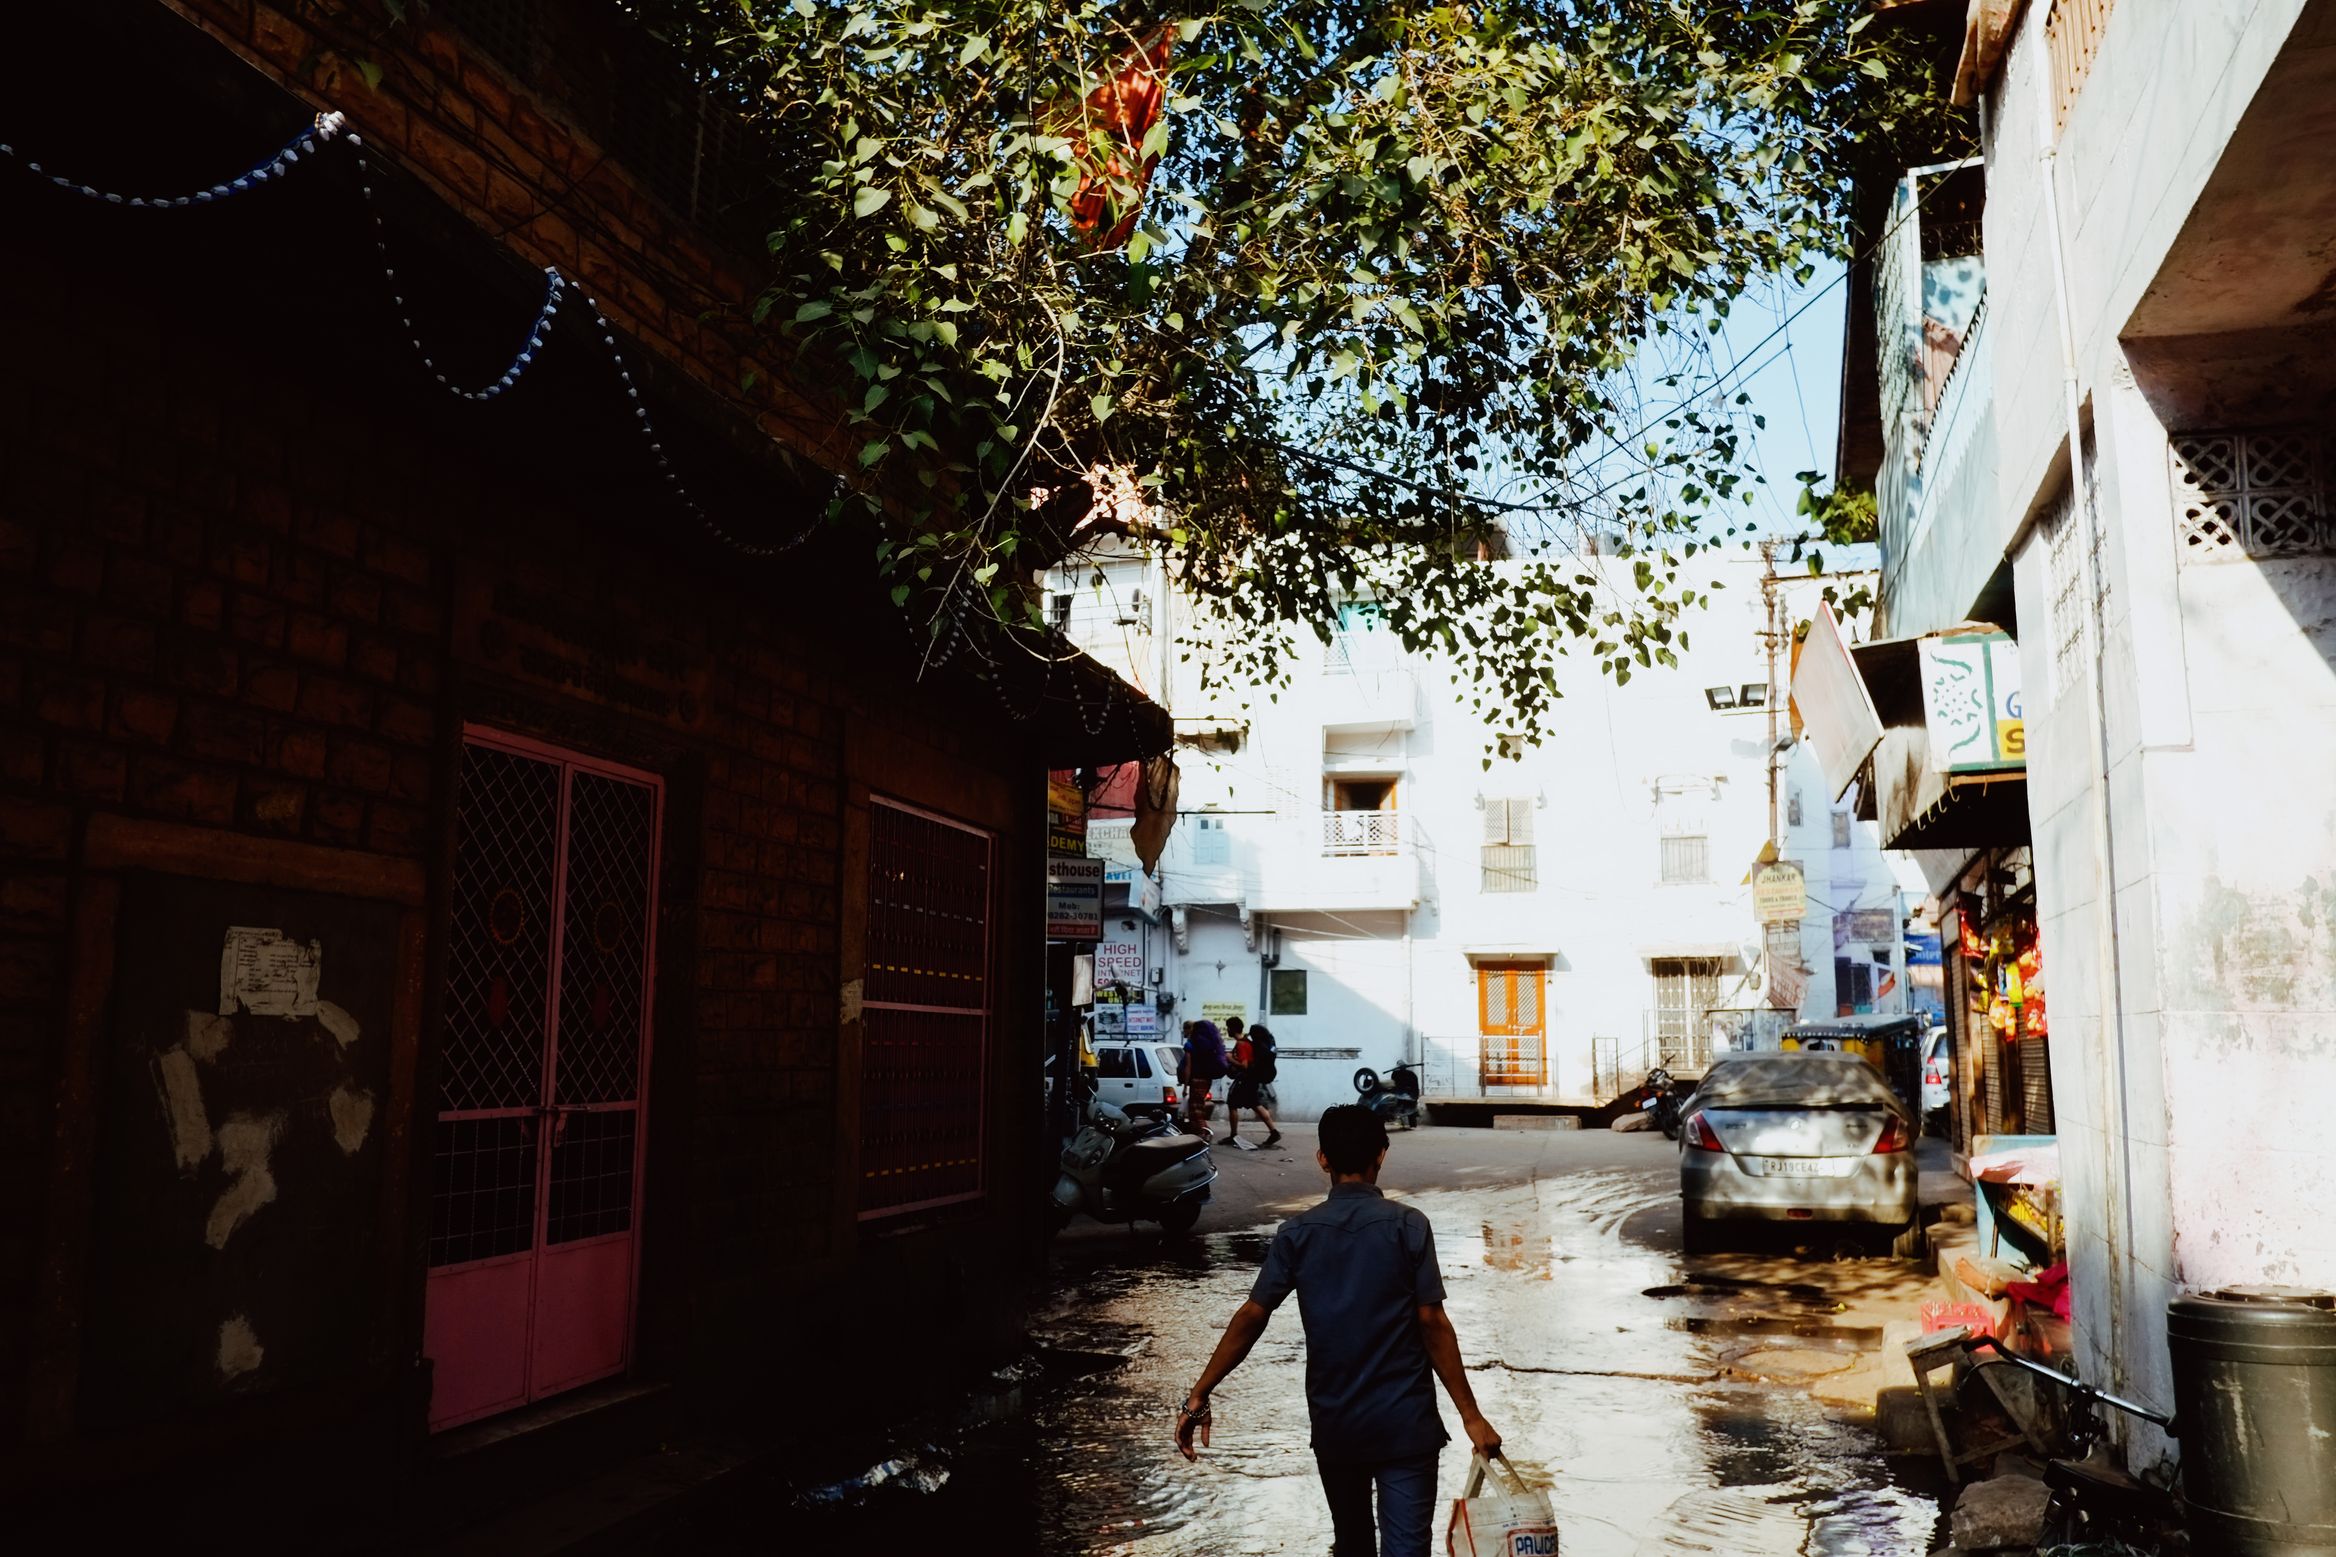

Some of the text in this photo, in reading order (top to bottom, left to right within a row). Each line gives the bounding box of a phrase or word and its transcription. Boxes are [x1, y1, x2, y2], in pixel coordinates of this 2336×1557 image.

[1049, 862, 1100, 877] sthouse
[1103, 944, 1137, 955] HIGH
[1098, 957, 1142, 968] SPEED
[1097, 969, 1142, 977] INTNET
